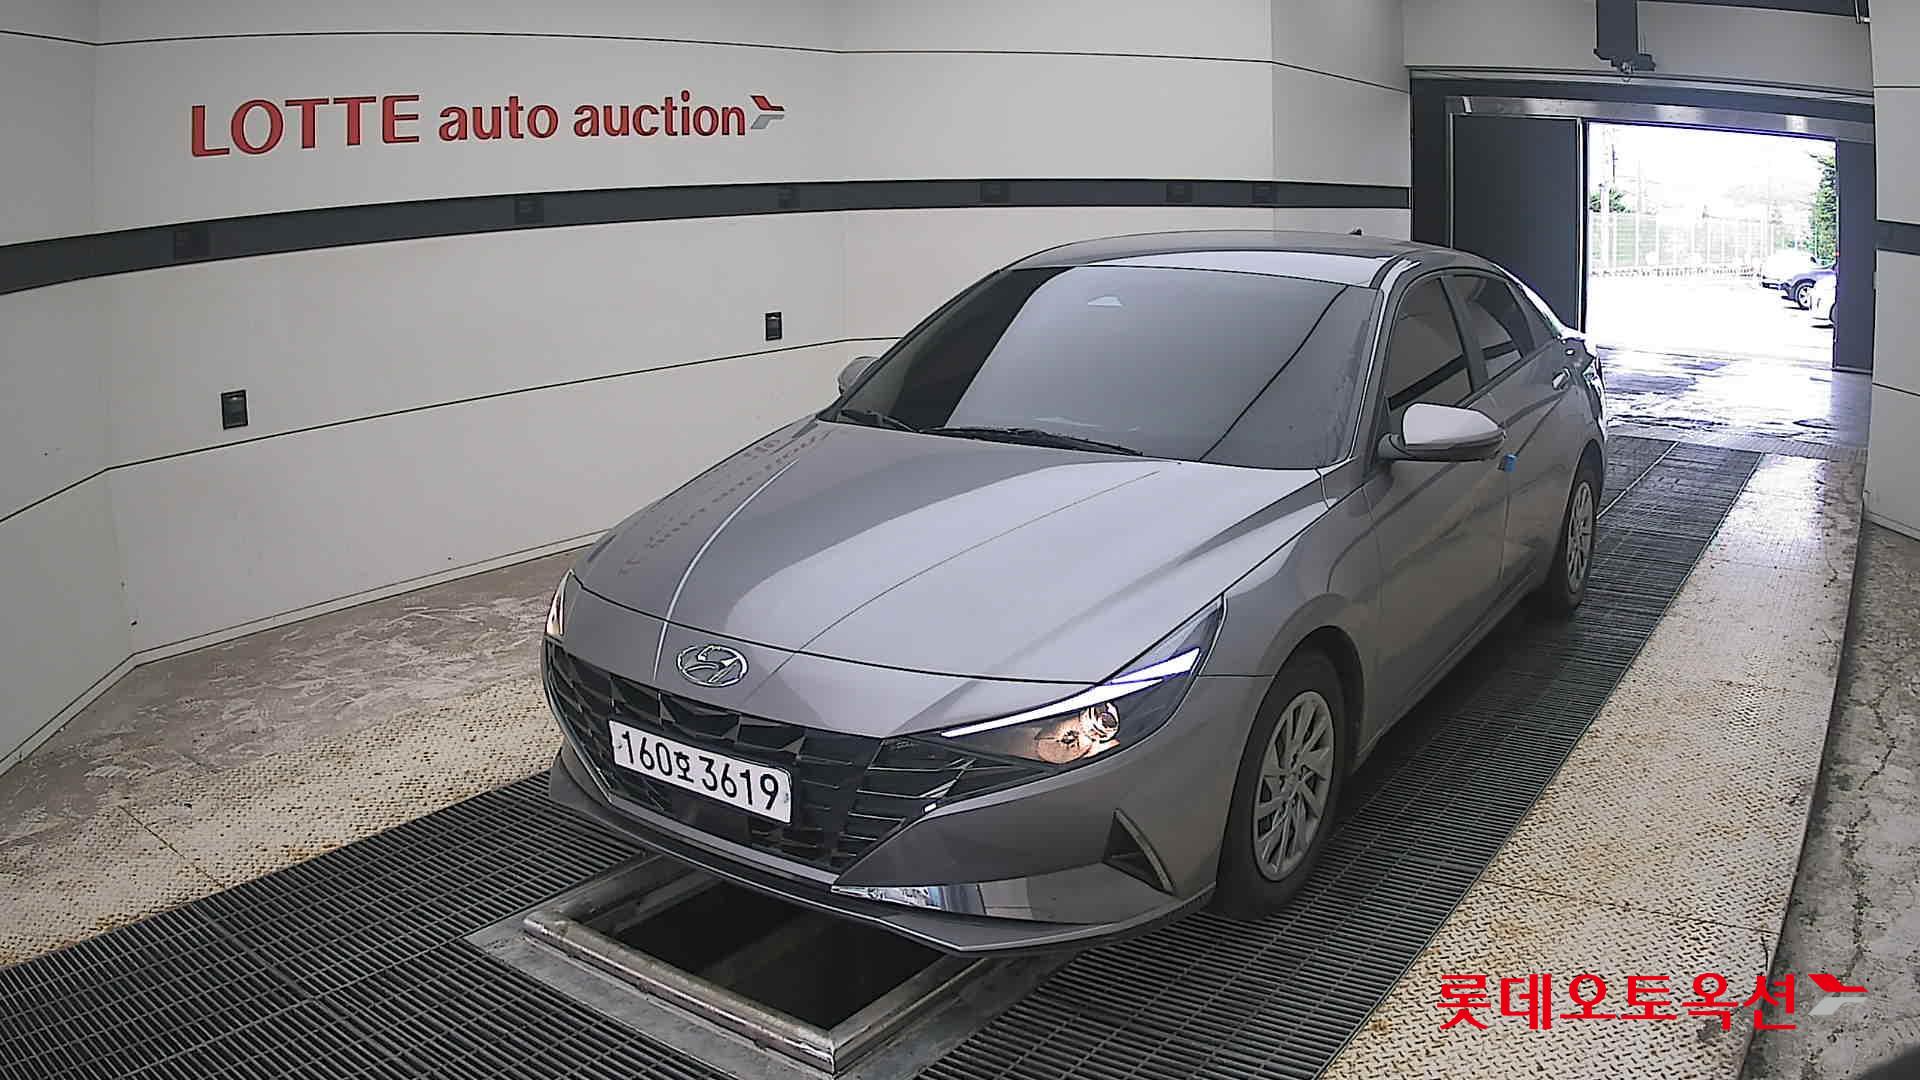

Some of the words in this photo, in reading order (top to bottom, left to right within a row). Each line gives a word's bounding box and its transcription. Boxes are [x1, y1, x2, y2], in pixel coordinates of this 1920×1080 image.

[191, 94, 420, 157] LOTTE
[438, 95, 559, 141] auto
[573, 89, 746, 137] auction
